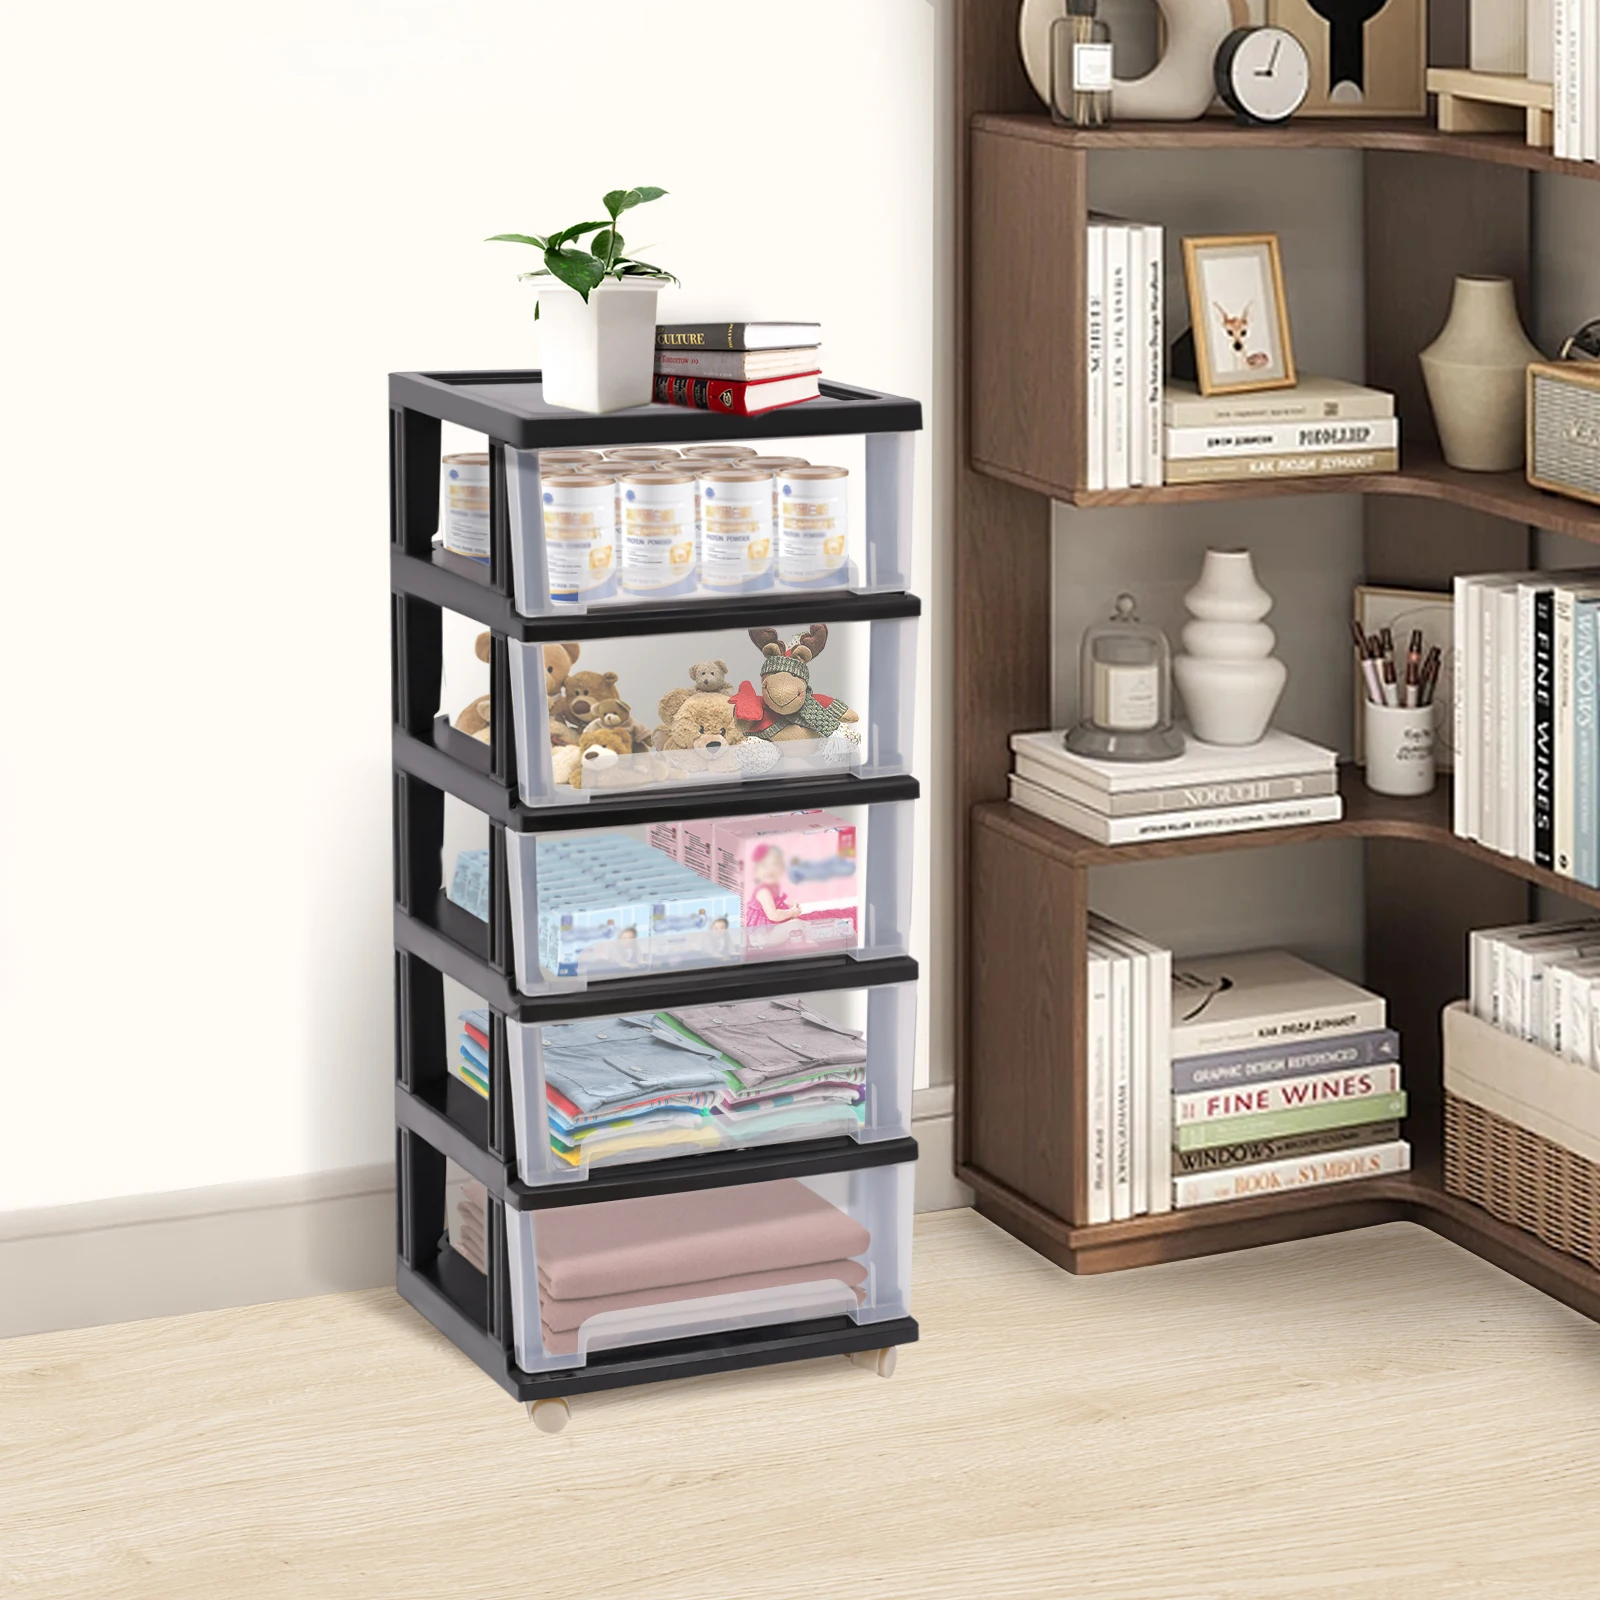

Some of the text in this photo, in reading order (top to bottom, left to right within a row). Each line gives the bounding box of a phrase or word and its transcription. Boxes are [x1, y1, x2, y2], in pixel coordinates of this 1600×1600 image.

[657, 333, 705, 345] CULTURE
[662, 355, 690, 365] Tomorrow
[1249, 459, 1276, 472] КАК
[1278, 458, 1316, 472] ЛЮДИ
[1320, 455, 1374, 470] ДУМАЮТ
[1536, 631, 1550, 706] FINE
[1576, 612, 1594, 728] WINDOWS
[1536, 721, 1550, 829] WINES
[1184, 781, 1270, 806] NOGUCHI
[1192, 1064, 1242, 1083] GRAPHIC
[1245, 1058, 1286, 1077] DESIGN
[1207, 1089, 1269, 1116] FINE
[1281, 1074, 1373, 1105] WINES
[1180, 1141, 1277, 1170] WINDOWS
[1235, 1170, 1281, 1195] BOOK
[1298, 1154, 1381, 1184] SYMBOLS
